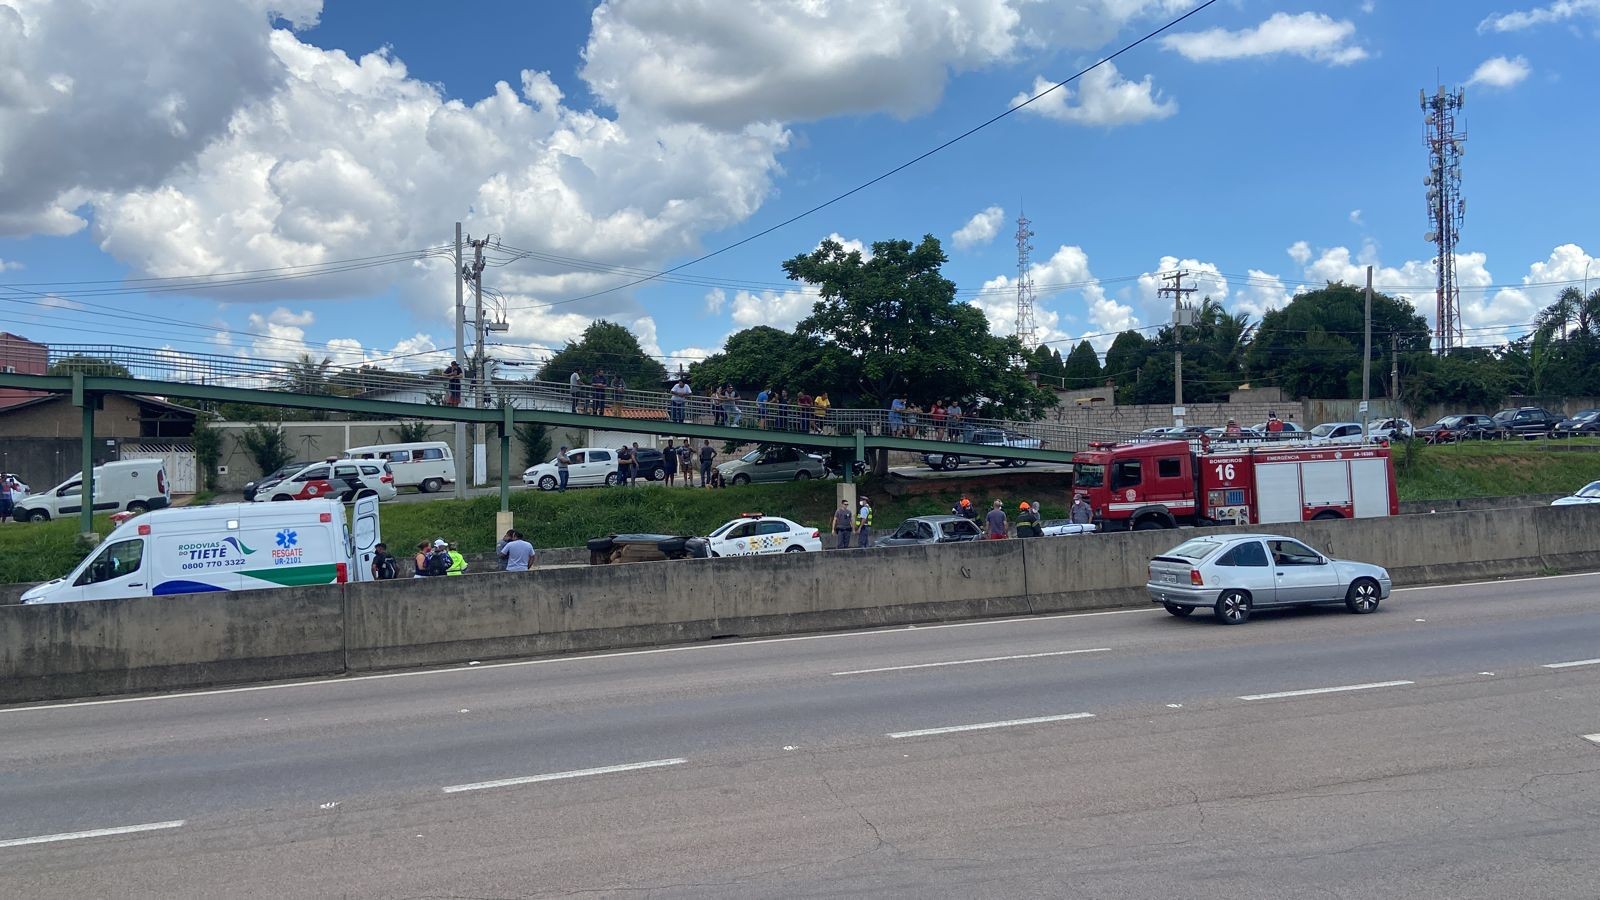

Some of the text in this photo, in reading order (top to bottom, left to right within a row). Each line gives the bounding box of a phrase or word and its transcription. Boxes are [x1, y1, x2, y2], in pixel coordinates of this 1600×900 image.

[1215, 463, 1235, 481] 16
[178, 542, 220, 551] RODOVIAS
[189, 545, 227, 560] TIETÊ
[271, 548, 303, 558] RESGATE
[274, 557, 301, 565] UR-2101
